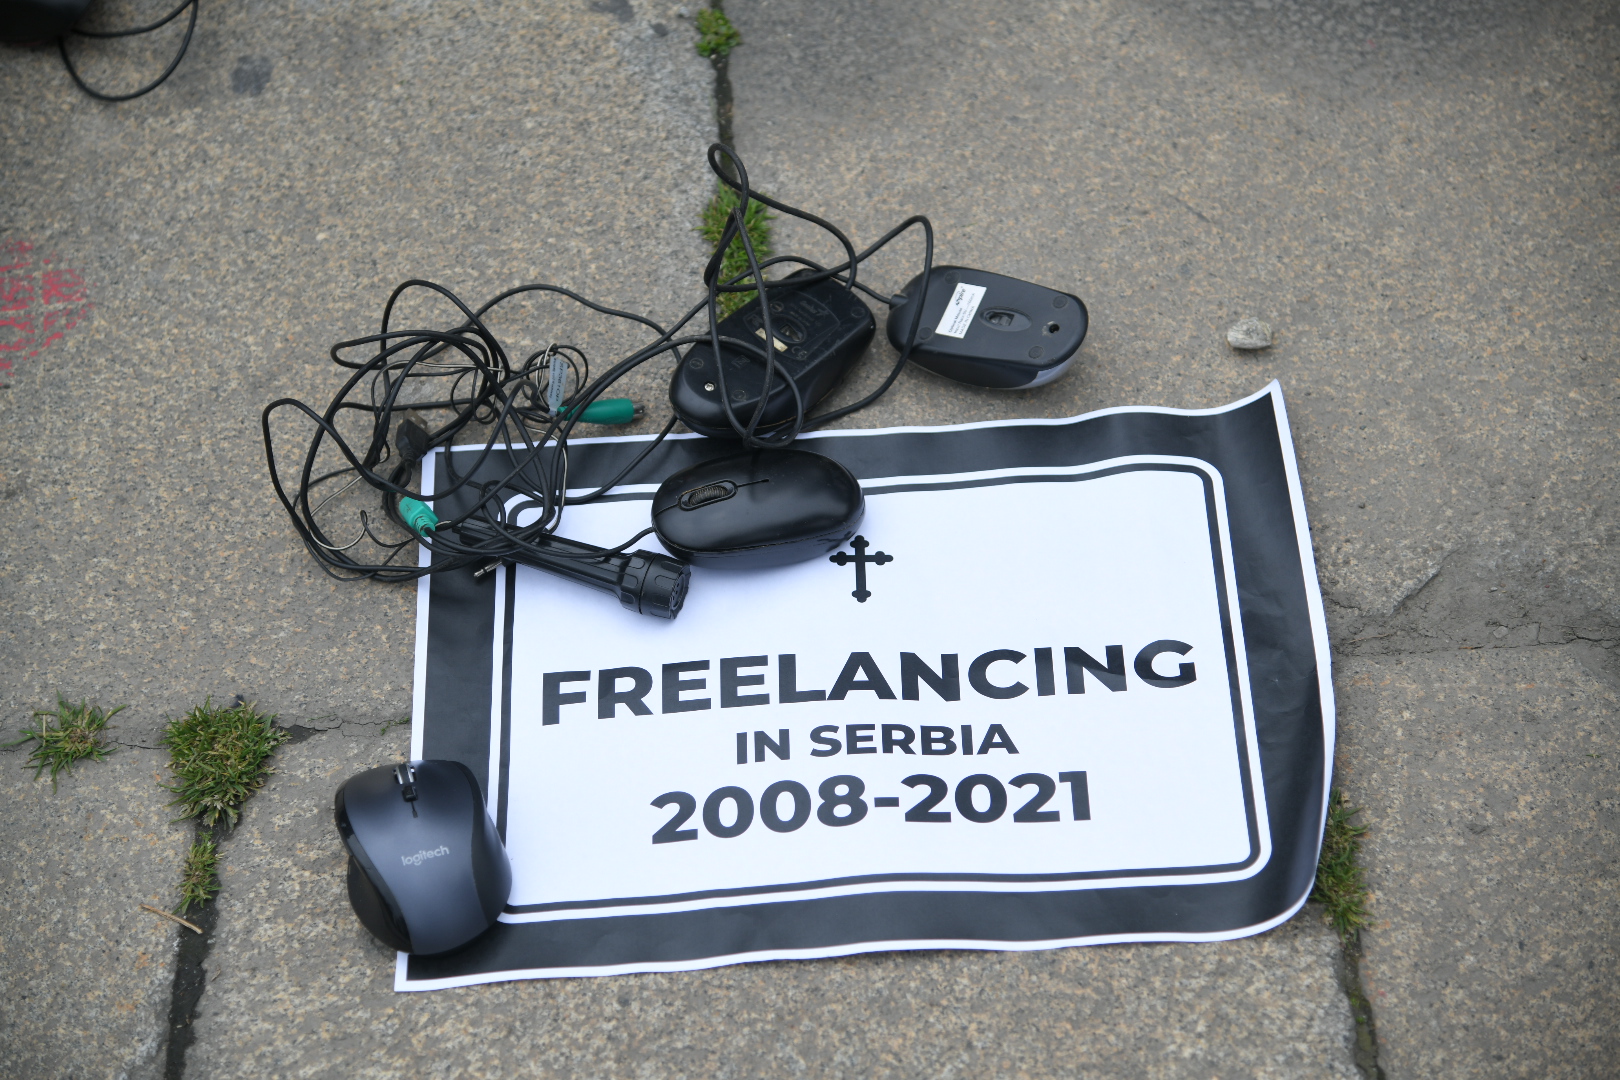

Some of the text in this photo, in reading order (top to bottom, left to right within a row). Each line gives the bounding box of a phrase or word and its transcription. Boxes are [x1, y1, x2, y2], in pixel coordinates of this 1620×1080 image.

[542, 639, 1197, 726] FREELANCING
[736, 723, 1020, 765] IN SERBIA
[649, 770, 1092, 845] 2008-2021
[401, 845, 450, 866] logitech
